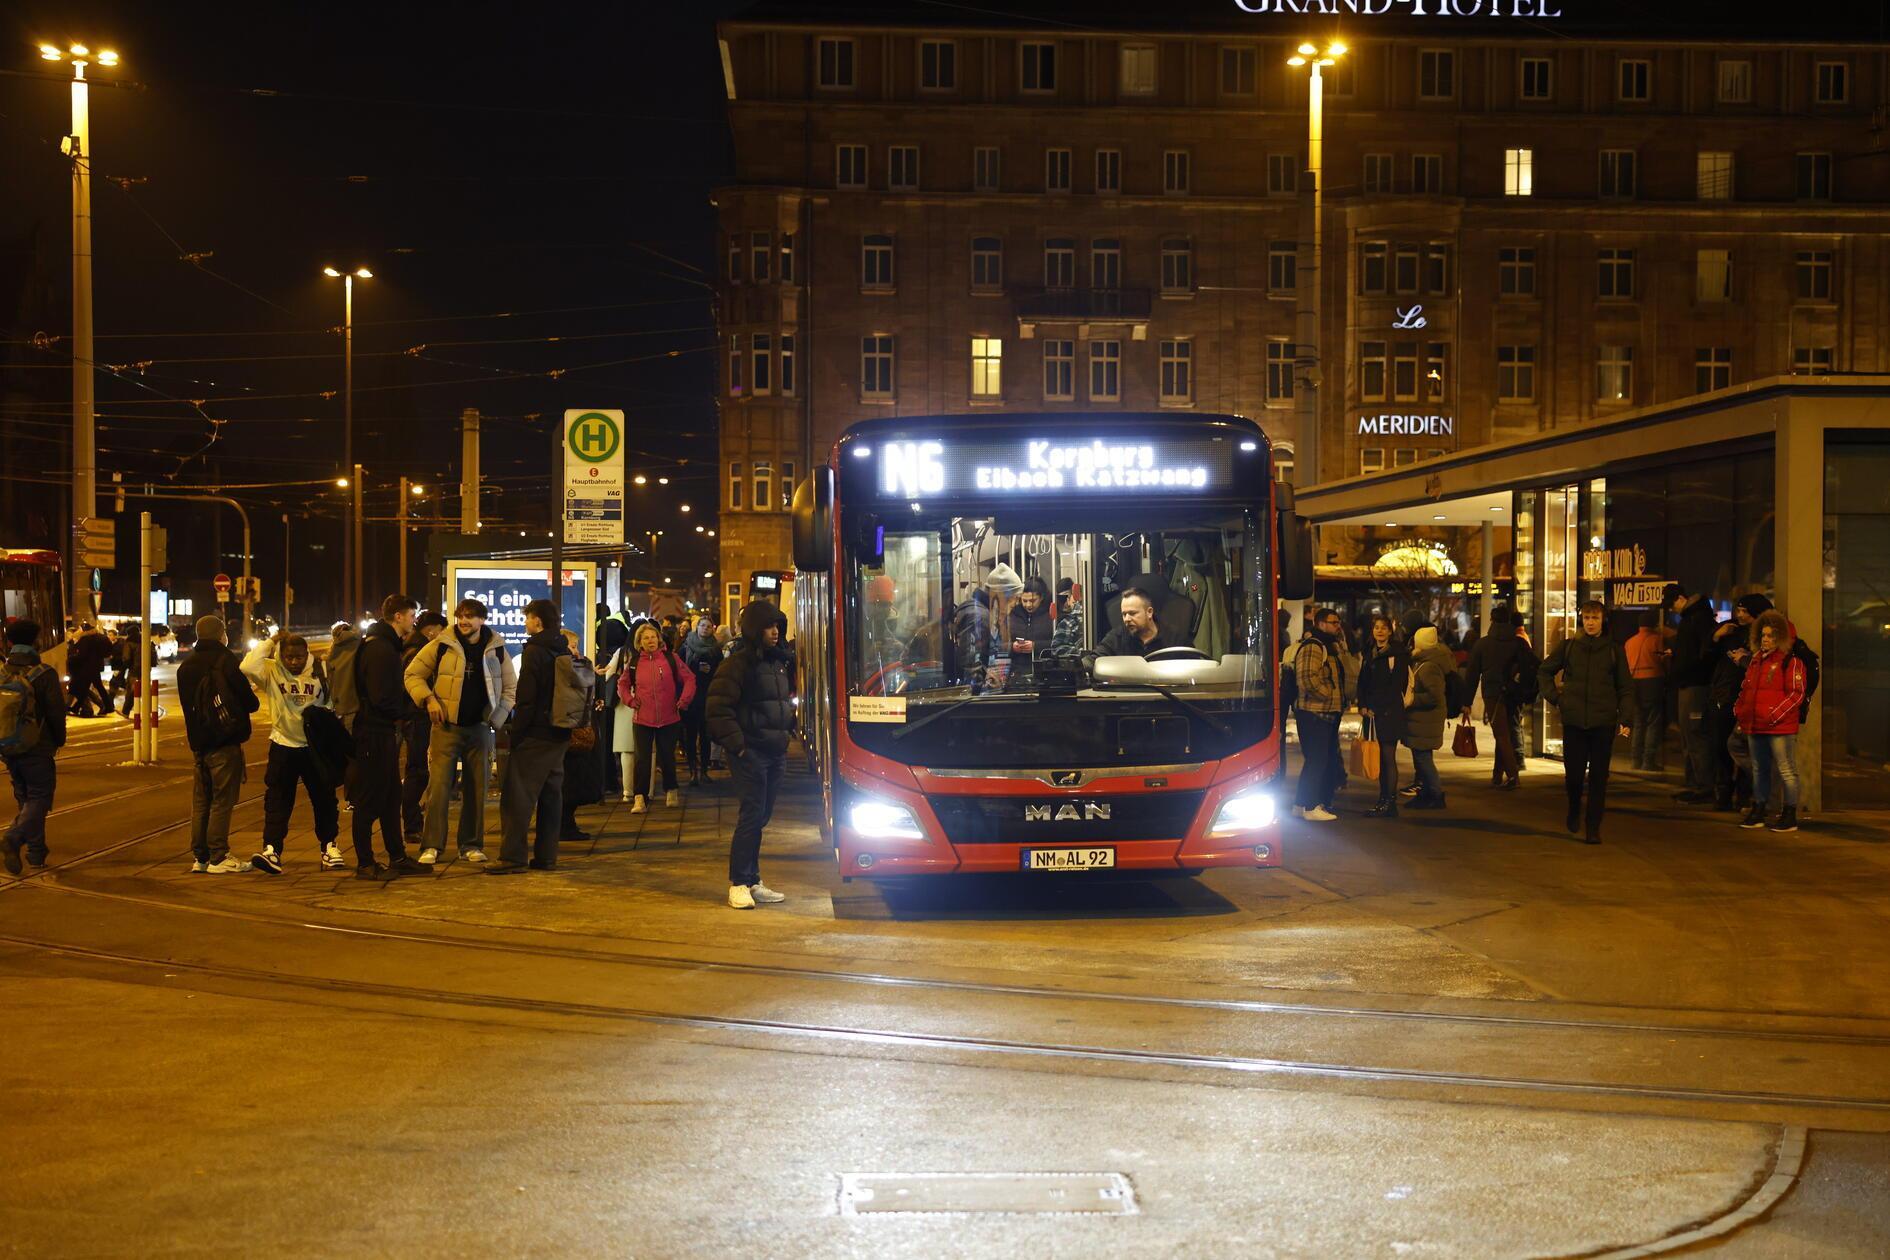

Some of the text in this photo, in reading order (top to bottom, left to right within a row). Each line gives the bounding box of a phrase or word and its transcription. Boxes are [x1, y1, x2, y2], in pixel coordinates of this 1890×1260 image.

[1392, 304, 1427, 329] Le
[1358, 415, 1452, 435] MERIDIEN
[582, 424, 606, 451] H
[885, 441, 1154, 492] N6 Kornburg
[572, 478, 617, 486] Hauptbahnhof
[1076, 467, 1207, 488] Katzwang
[464, 590, 532, 606] Sei ein
[1613, 582, 1633, 605] VAG
[1025, 803, 1111, 821] MAN
[1036, 852, 1056, 866] NM
[1066, 851, 1086, 866] AL
[1089, 850, 1107, 865] 92
